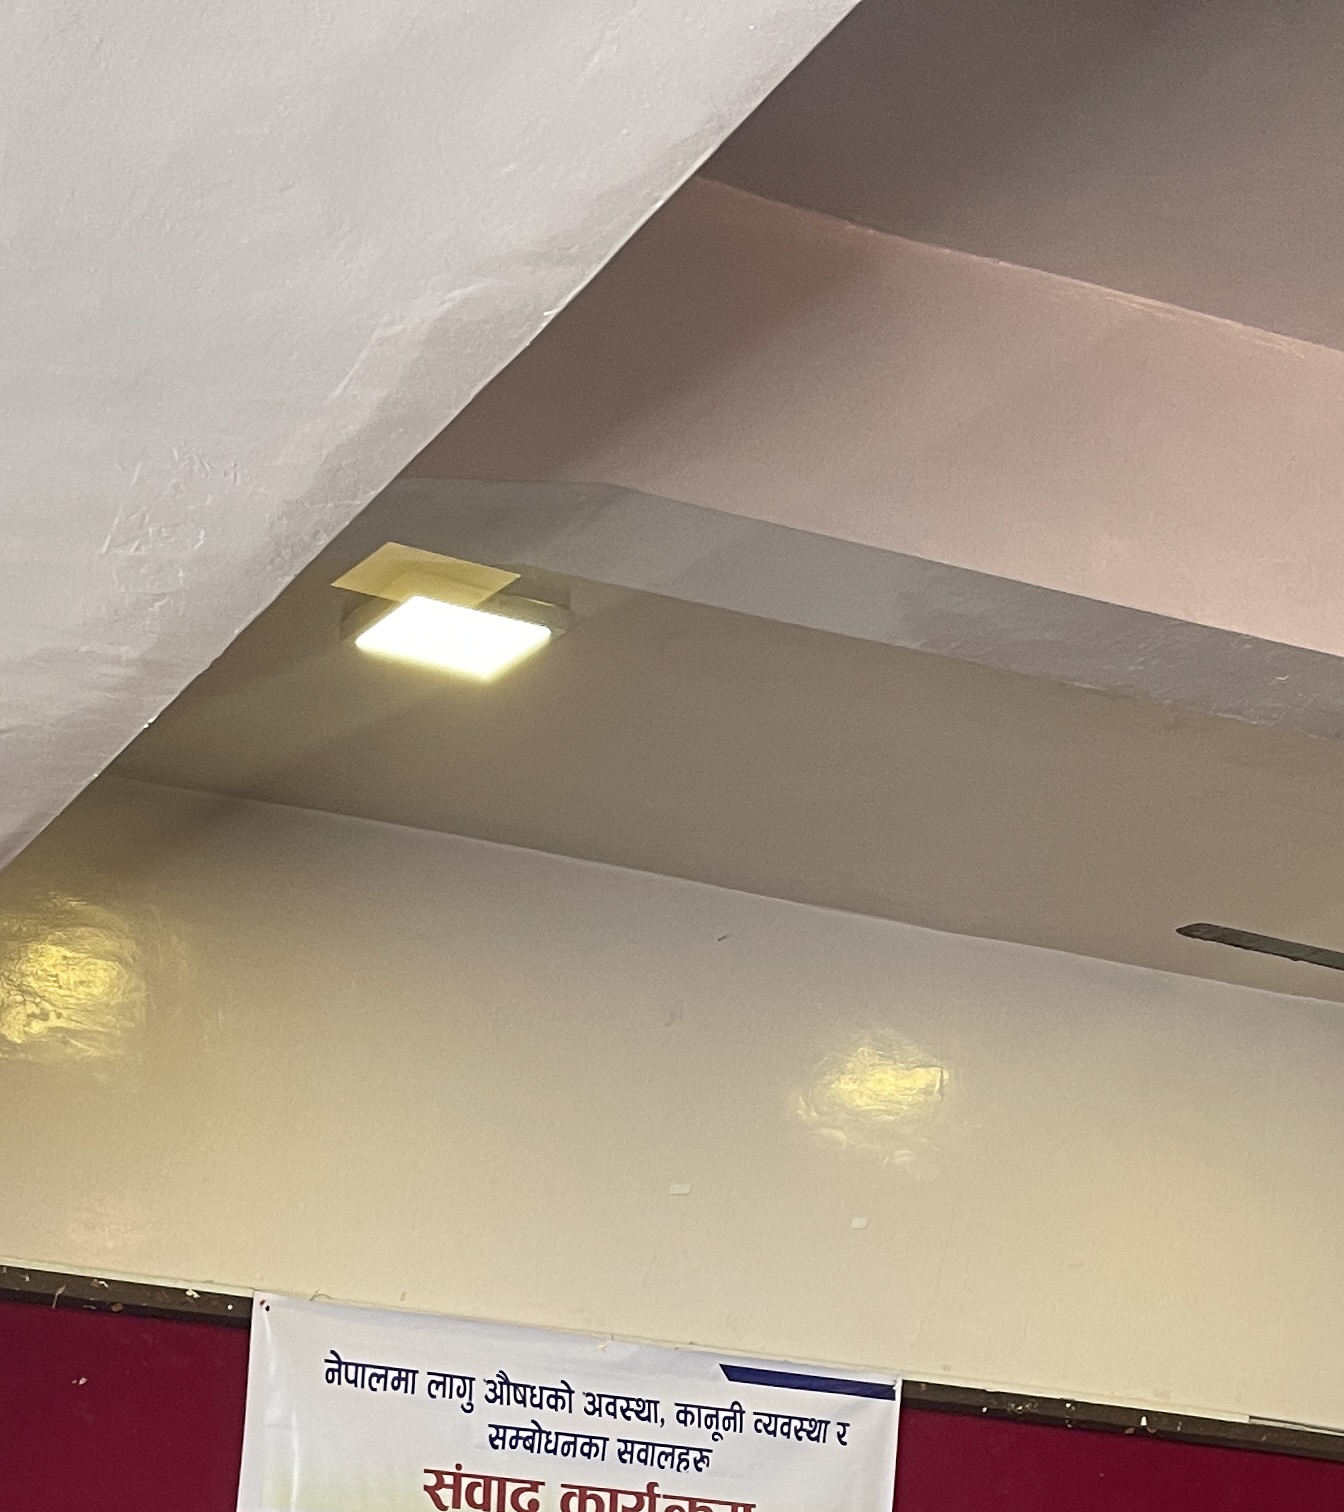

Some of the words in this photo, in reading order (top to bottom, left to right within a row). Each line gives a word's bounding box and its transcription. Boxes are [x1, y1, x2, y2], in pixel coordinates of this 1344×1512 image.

[324, 1350, 419, 1395] नेपालमा
[427, 1371, 476, 1414] लागु
[483, 1370, 575, 1414] औषधको
[582, 1391, 666, 1429] अवस्था,
[674, 1400, 746, 1442] कानूनी
[753, 1411, 831, 1444] व्यवस्था
[836, 1421, 850, 1447] र
[487, 1419, 610, 1462] सम्बोधनका
